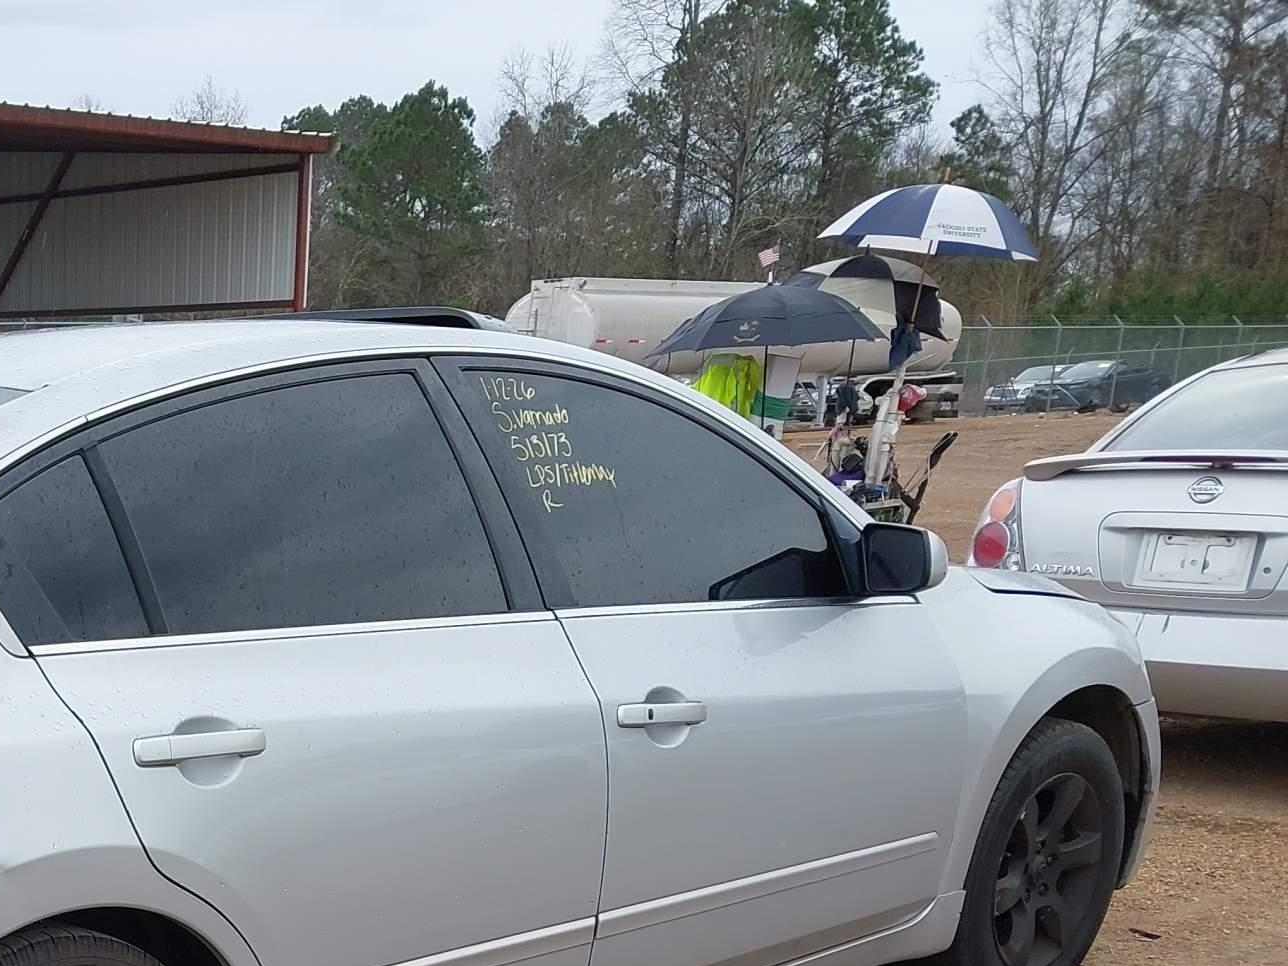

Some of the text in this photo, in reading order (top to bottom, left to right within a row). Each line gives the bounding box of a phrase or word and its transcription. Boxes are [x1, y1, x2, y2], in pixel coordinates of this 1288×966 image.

[943, 229, 981, 239] UNIVERSITY
[542, 488, 564, 513] R
[1030, 563, 1095, 577] ALTIMA
